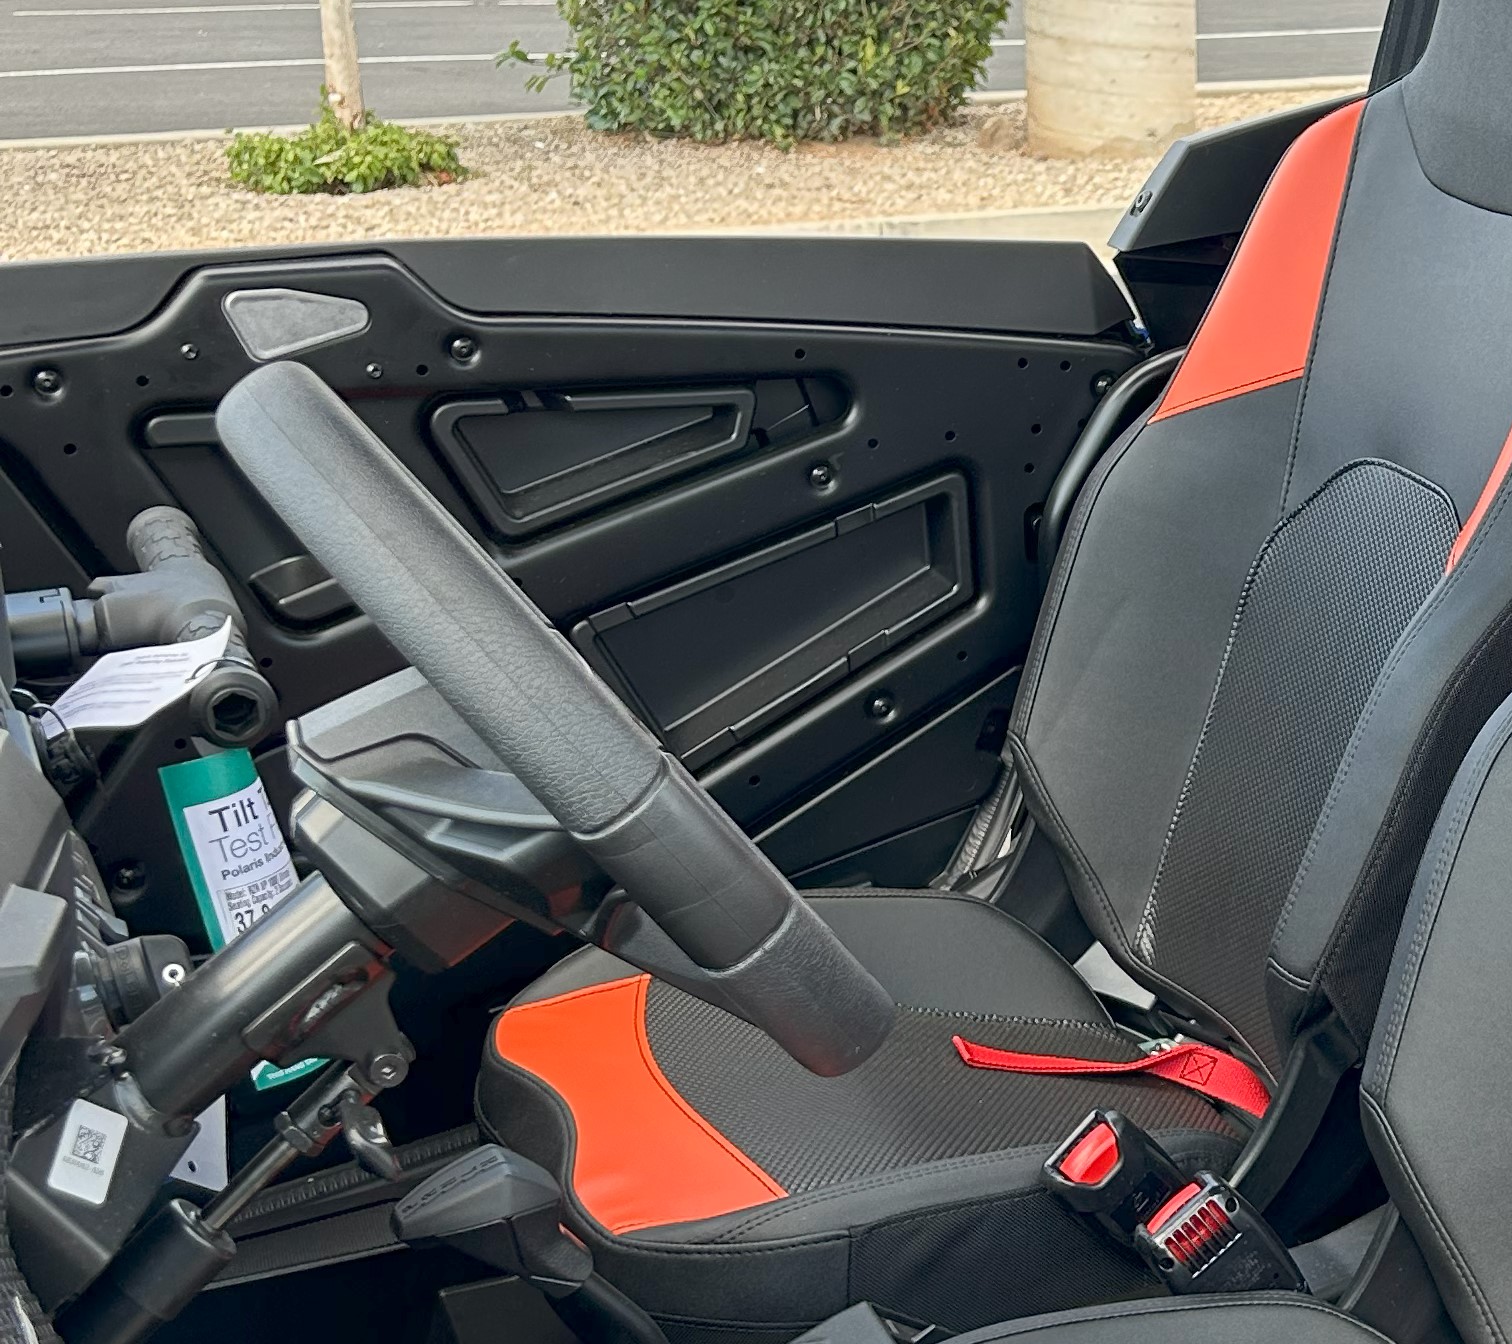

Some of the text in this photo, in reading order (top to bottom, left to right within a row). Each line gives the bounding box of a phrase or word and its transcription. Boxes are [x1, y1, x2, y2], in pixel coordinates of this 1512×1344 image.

[208, 797, 259, 833] Tilt
[208, 823, 269, 863] Test
[221, 857, 264, 881] Polaris
